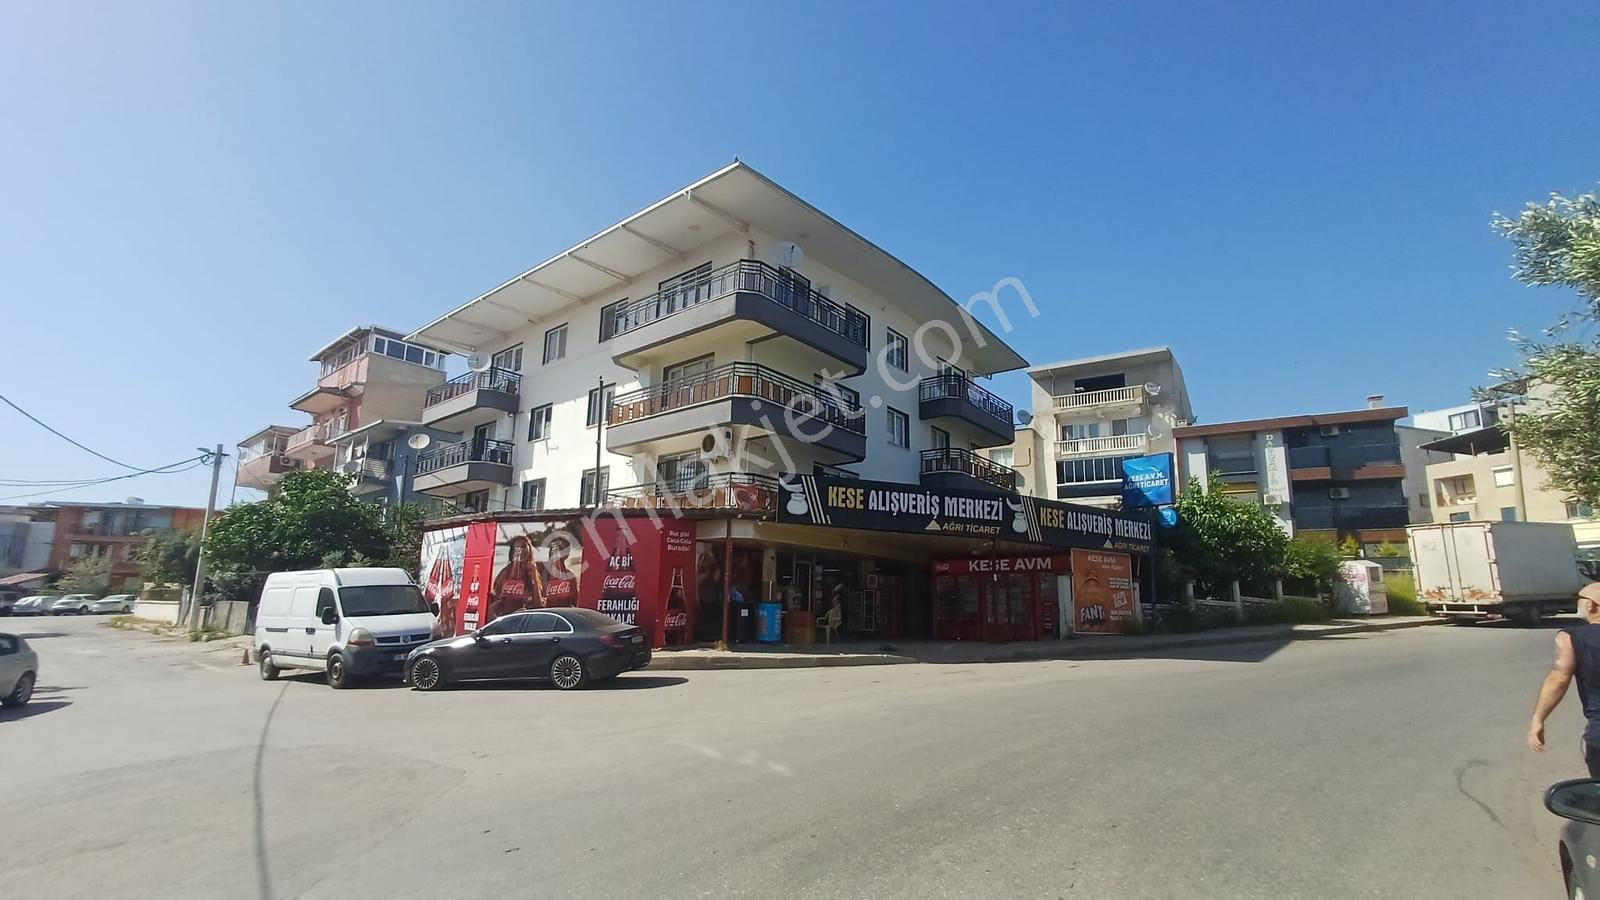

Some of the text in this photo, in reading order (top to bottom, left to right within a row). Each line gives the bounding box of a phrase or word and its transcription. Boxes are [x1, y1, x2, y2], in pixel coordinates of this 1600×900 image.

[828, 486, 1003, 521] KESE ALIŞVERİŞ MERKEZİ
[942, 521, 1001, 535] AĞRI TİCARET
[1040, 506, 1151, 540] KESE ALIŞVERİŞ MERKEZİ
[609, 556, 620, 570] AÇ
[968, 557, 1052, 572] KESE AVM
[597, 597, 640, 611] FERAHLIĞI
